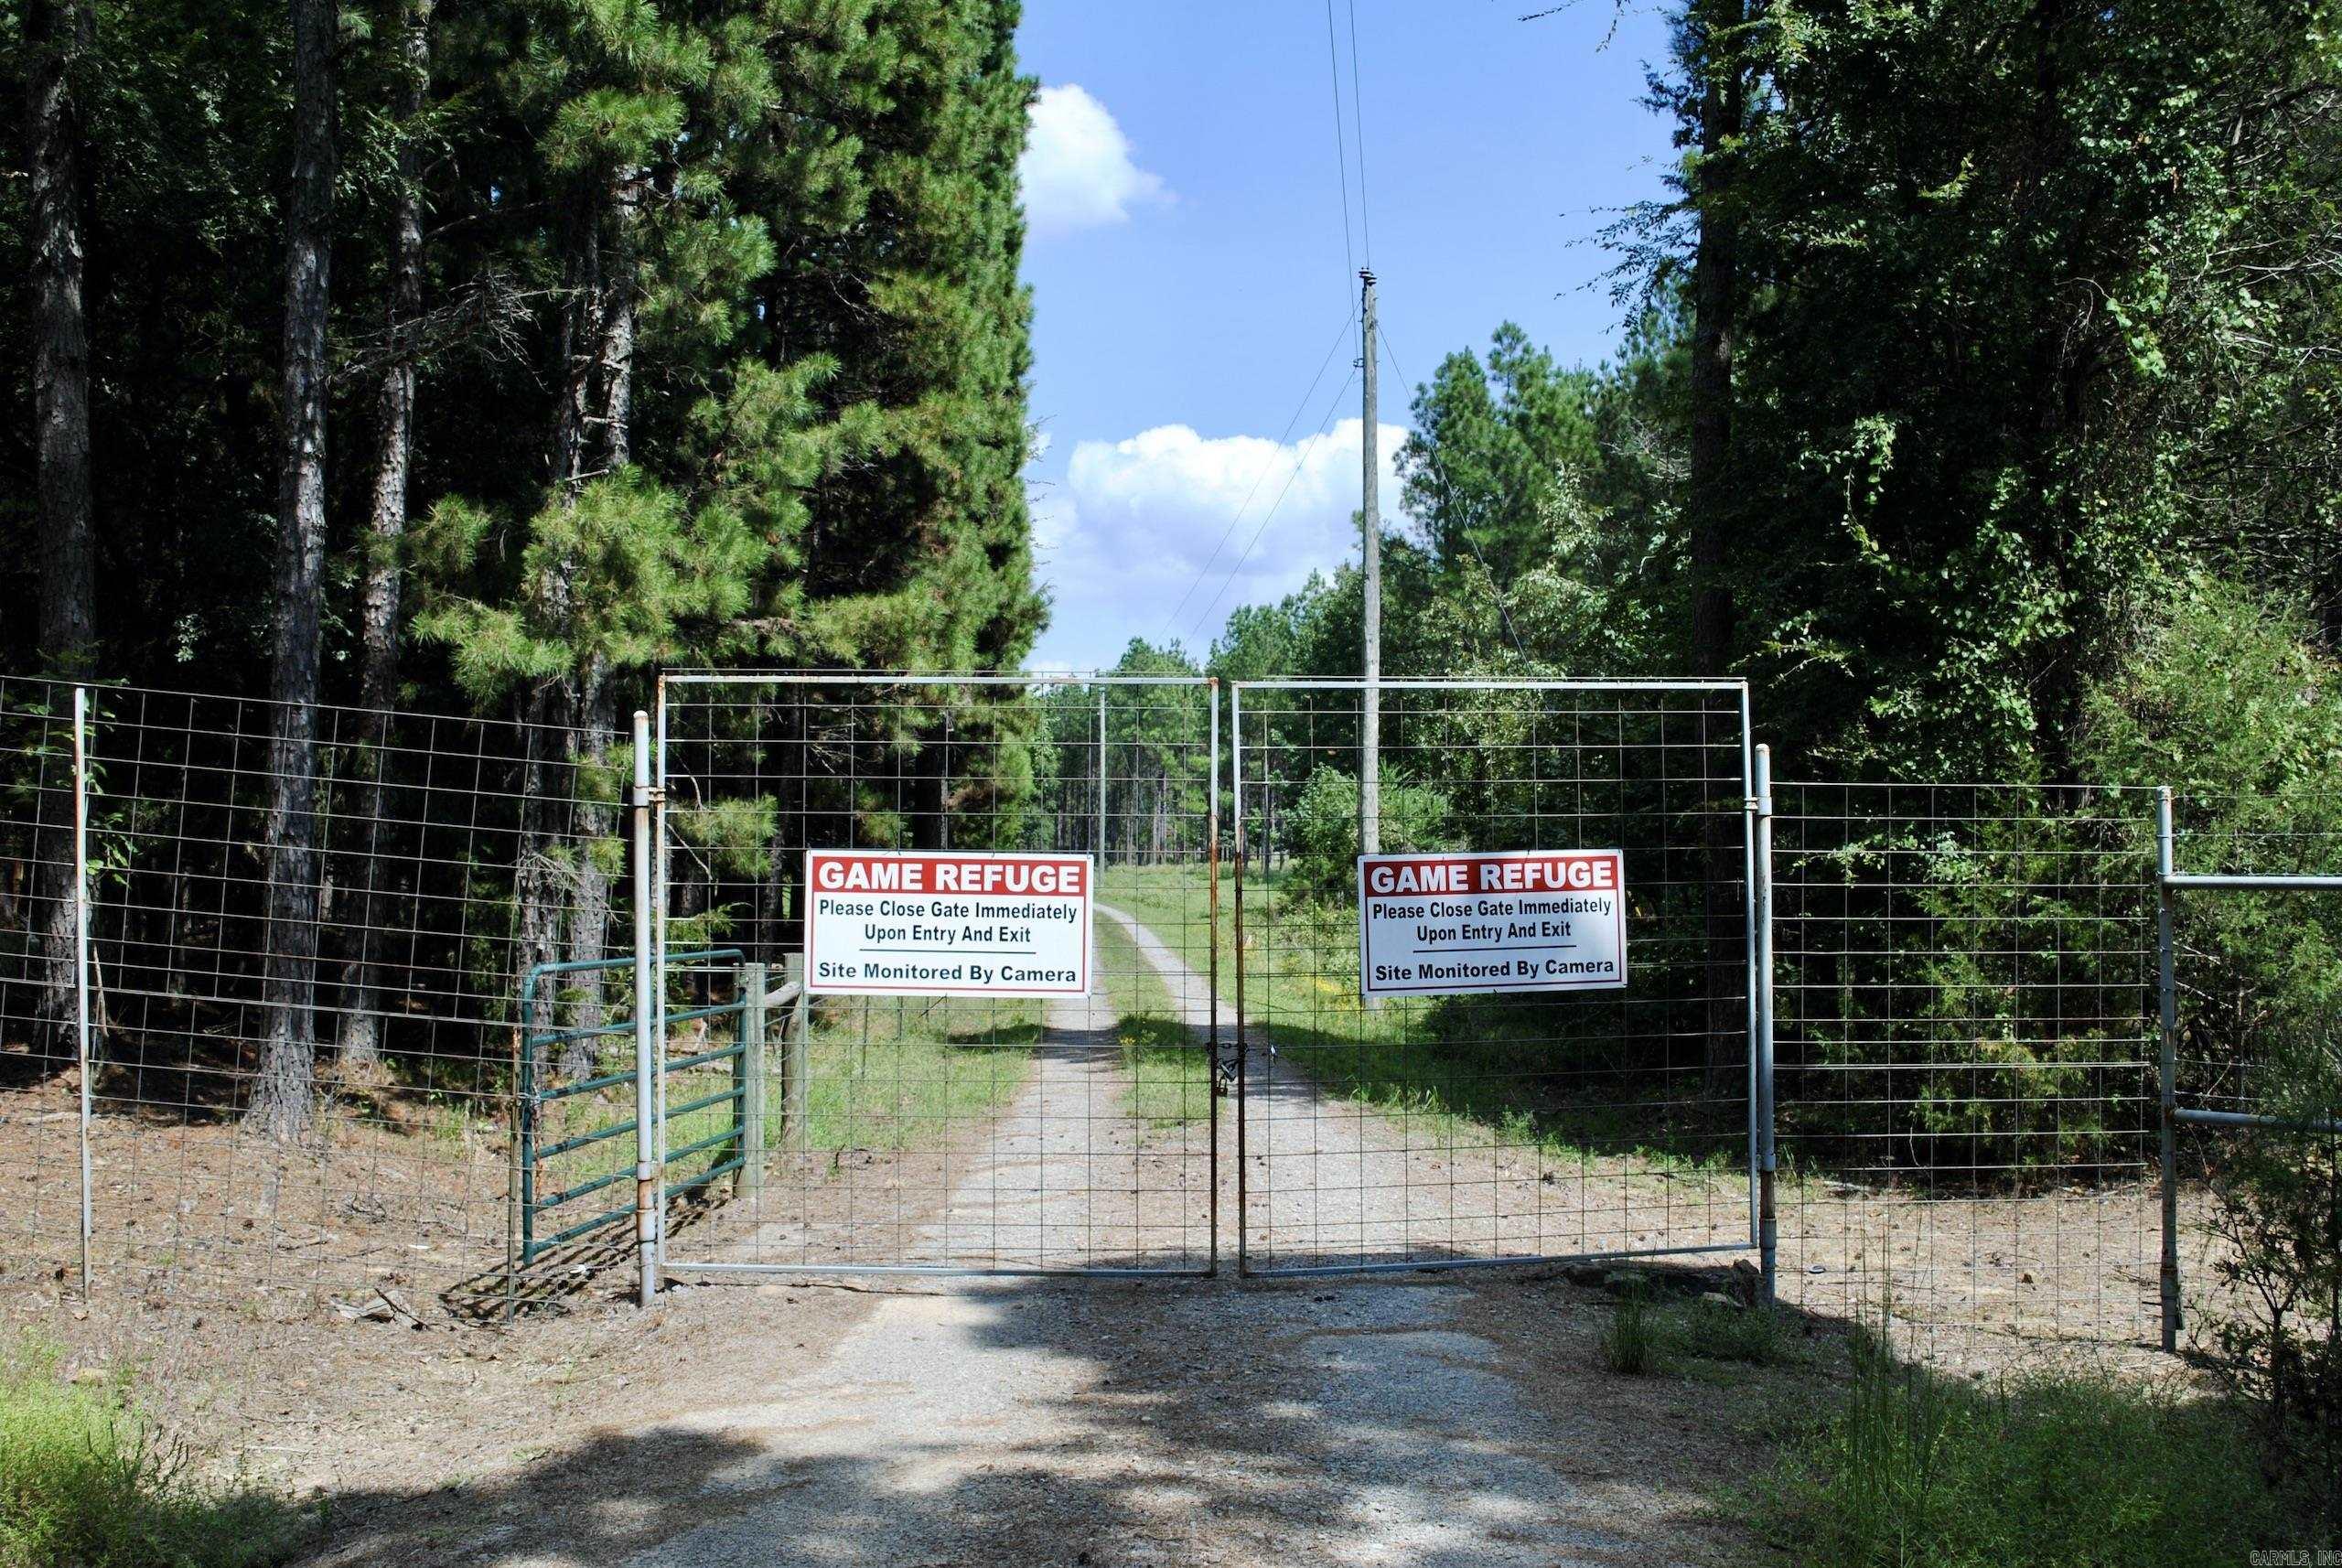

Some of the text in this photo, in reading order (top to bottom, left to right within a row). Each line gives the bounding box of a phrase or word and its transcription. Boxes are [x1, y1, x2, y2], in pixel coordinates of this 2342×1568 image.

[819, 861, 1080, 893] GAME REFUGE
[1370, 861, 1612, 893] GAME REFUGE
[820, 899, 1077, 923] Please Close Gate Immediately
[1373, 897, 1611, 918] Please Close Gate Immediately
[865, 924, 1031, 945] Upon Entry And Exit
[1417, 921, 1571, 944] Upon Entry And Exit
[819, 962, 1076, 984] Site Monitored By Camera
[1376, 959, 1614, 981] Site Monitored By Camera
